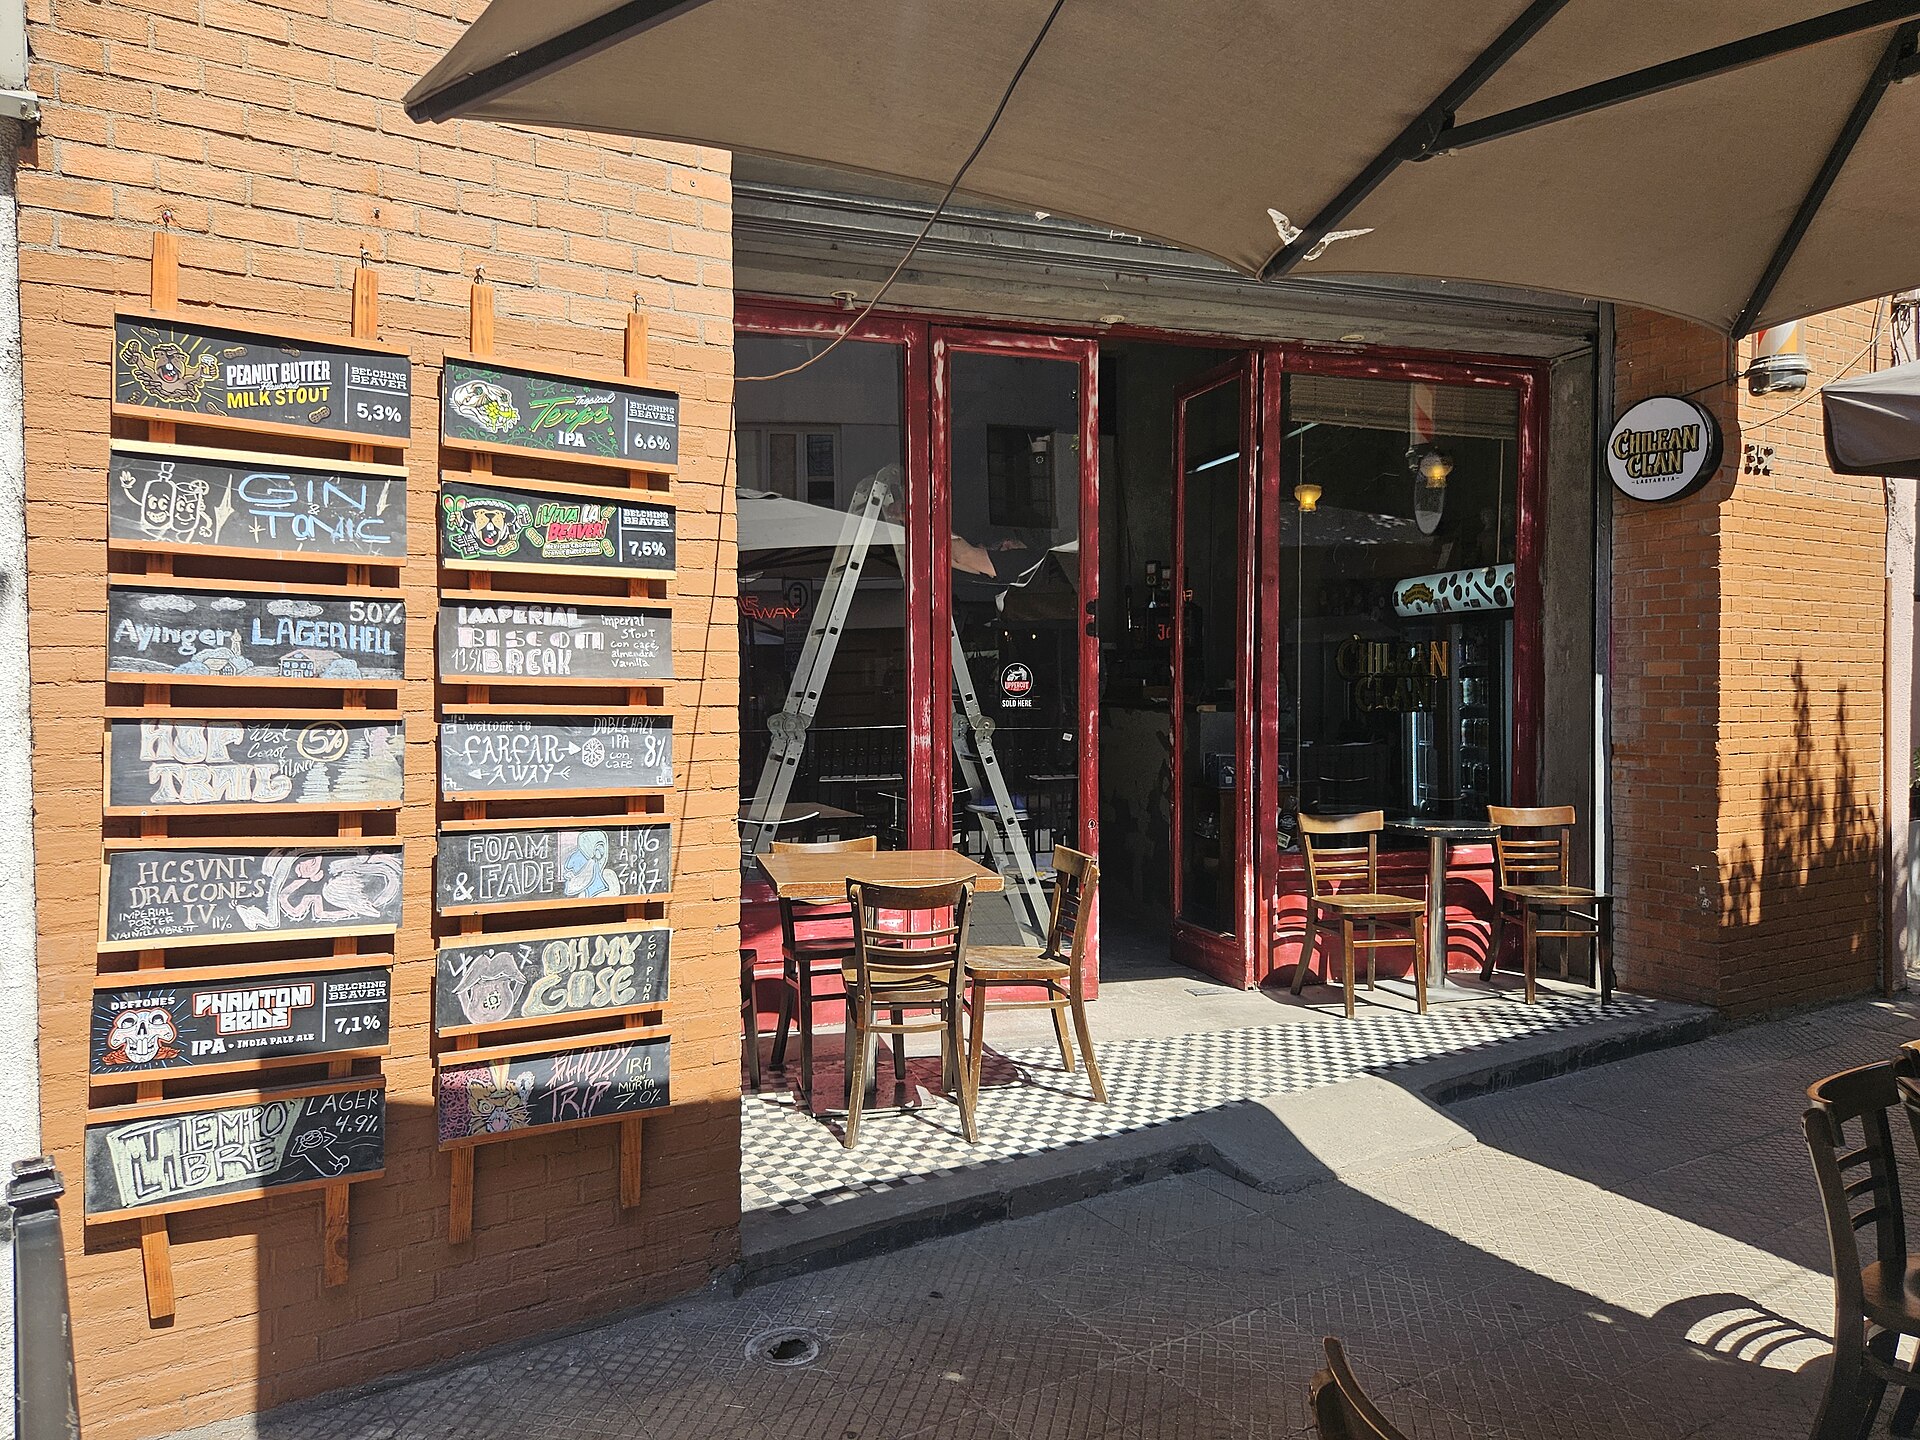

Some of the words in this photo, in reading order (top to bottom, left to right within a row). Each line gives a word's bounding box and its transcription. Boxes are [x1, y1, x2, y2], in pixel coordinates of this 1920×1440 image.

[226, 363, 280, 386] PEANUT
[281, 360, 331, 383] BUTTER
[350, 374, 408, 390] BEAVER
[351, 366, 407, 381] BELCHING
[227, 391, 272, 409] MILK
[274, 386, 330, 406] STOUT
[629, 402, 676, 414] BELCHING
[356, 402, 402, 423] 5,3%
[629, 409, 676, 422] BEAVER
[558, 430, 587, 448] IPA
[634, 432, 672, 451] 6,6%
[1611, 424, 1700, 460] CHILEAN
[1625, 449, 1684, 478] CLAN
[238, 473, 367, 511] GIN
[581, 503, 601, 524] LA
[623, 508, 670, 519] BELCHING
[623, 516, 670, 528] BEAVER
[249, 508, 392, 544] TONIC
[547, 519, 609, 542] BEAVER!
[628, 541, 667, 557] 7,5%
[350, 602, 405, 625] 5,0%
[458, 605, 583, 628] IMPERIAL
[112, 618, 232, 655] Ayinger
[251, 617, 348, 650] LAGER
[350, 624, 398, 656] HELL
[610, 640, 629, 648] con
[482, 648, 572, 676] BREAK
[1336, 634, 1448, 680] CHILEAN
[1004, 681, 1030, 690] UPPERCUT
[1001, 699, 1017, 708] SOLD
[1017, 699, 1032, 708] HERE
[140, 718, 244, 763] HOP
[303, 727, 344, 755] 5%
[611, 733, 630, 749] IPA
[644, 734, 667, 768] 8%
[487, 763, 554, 788] AWAY
[468, 834, 550, 863] FOAM
[453, 872, 475, 901] &
[479, 860, 555, 899] FADE
[129, 877, 267, 909] DRACONES
[119, 908, 175, 922] IMPERIAL
[128, 916, 175, 928] PORTER
[182, 903, 217, 926] IV
[542, 937, 590, 978] OH
[591, 934, 643, 966] MY
[648, 934, 657, 960] CON
[328, 980, 387, 993] BELCHING
[328, 988, 387, 1001] BEAVER
[521, 965, 637, 1018] GOSE
[110, 996, 176, 1011] DEFTONES
[195, 985, 312, 1015] PHANTOM
[220, 1007, 288, 1033] BRIDE
[334, 1015, 381, 1035] 7,1%
[191, 1038, 227, 1056] IPA
[236, 1037, 267, 1049] INDIA
[269, 1034, 294, 1046] PALE
[296, 1033, 315, 1042] ALE
[625, 1056, 652, 1075] IRA
[618, 1079, 655, 1093] MURTA
[306, 1088, 379, 1116] LAGER
[538, 1081, 612, 1124] TRIP
[613, 1088, 661, 1110] 7.0%
[119, 1102, 287, 1157] TIEMPO
[335, 1114, 379, 1134] 4.9%
[133, 1137, 276, 1198] LIBRE
